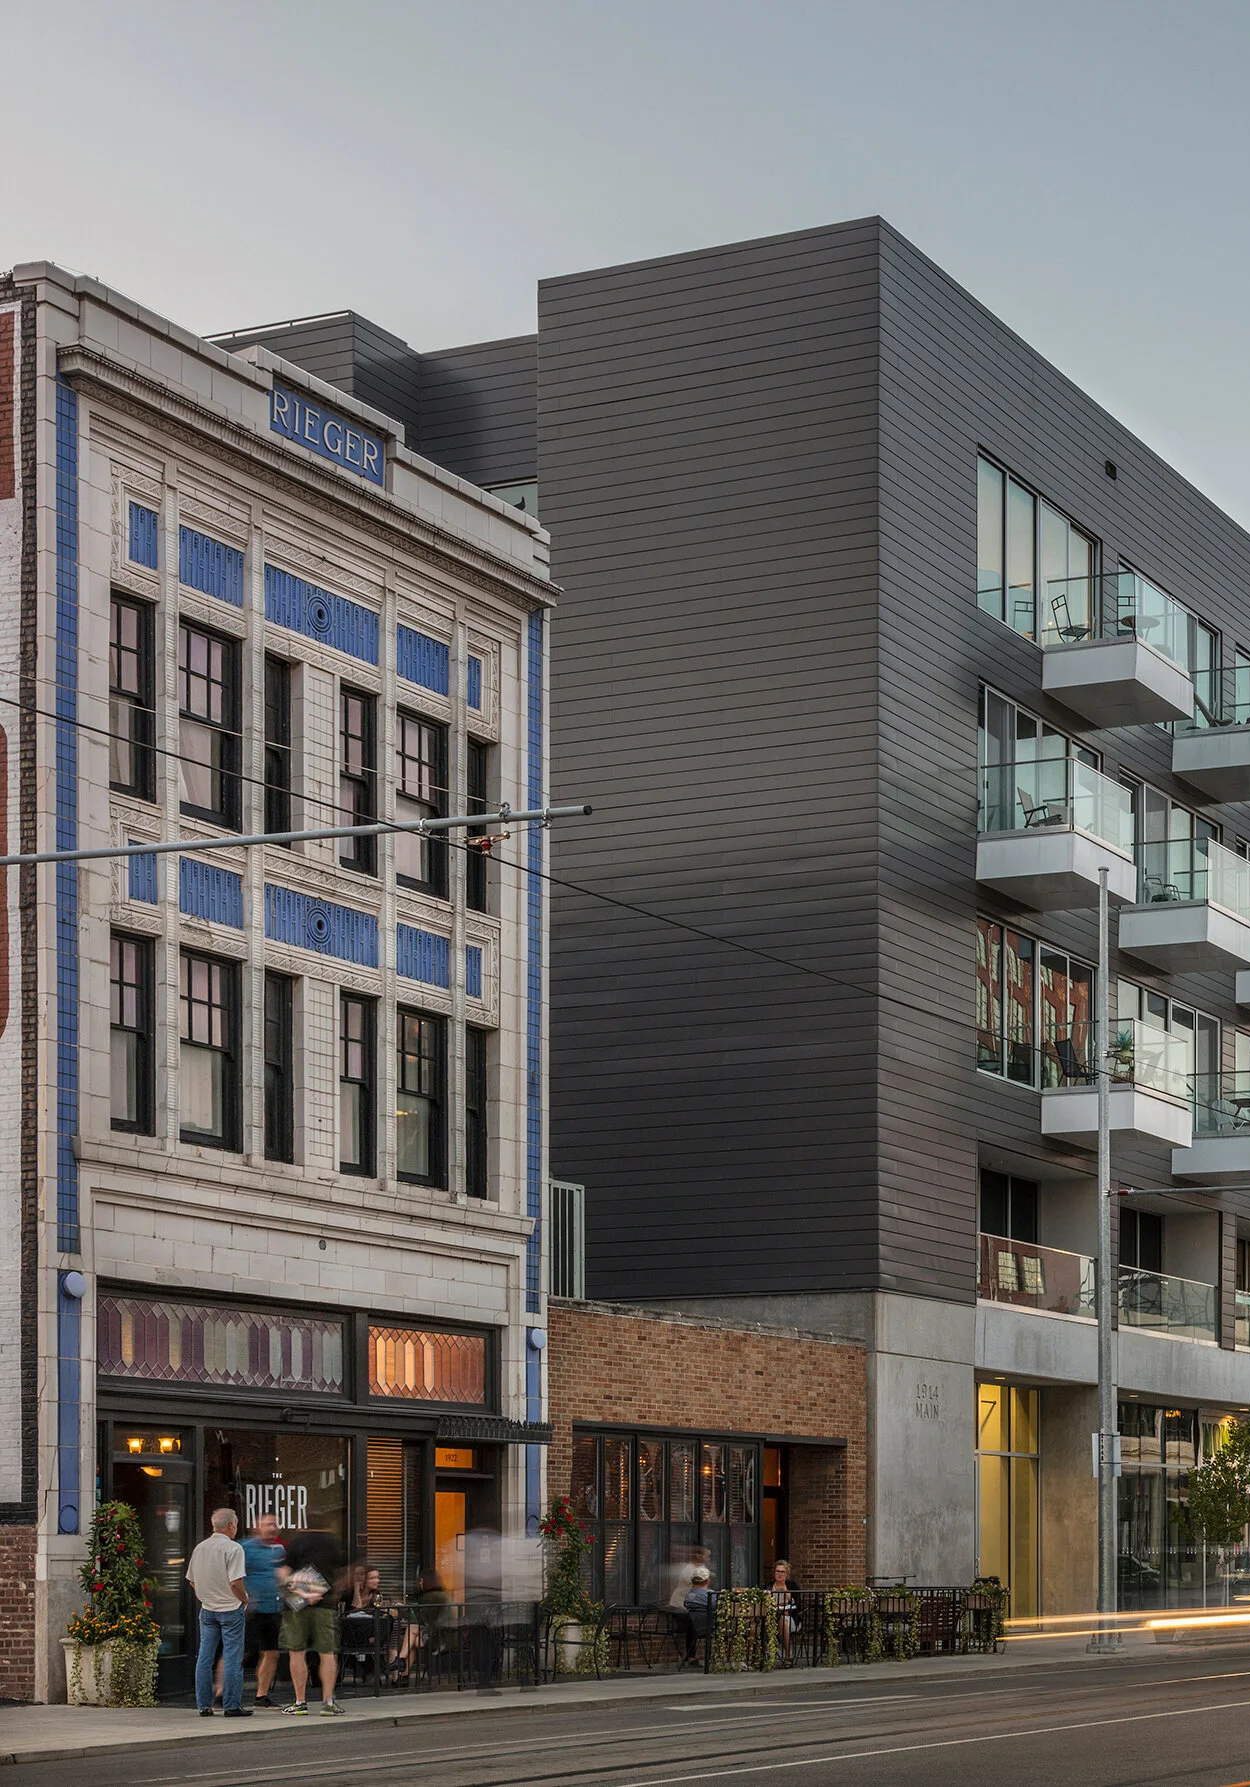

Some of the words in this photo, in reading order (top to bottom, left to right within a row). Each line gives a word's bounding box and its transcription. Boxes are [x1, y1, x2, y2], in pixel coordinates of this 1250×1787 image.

[272, 390, 379, 475] RIEGER
[916, 1383, 939, 1400] 1914
[915, 1402, 939, 1419] MAIN
[445, 1454, 458, 1462] 1922
[245, 1484, 308, 1530] RIEGER
